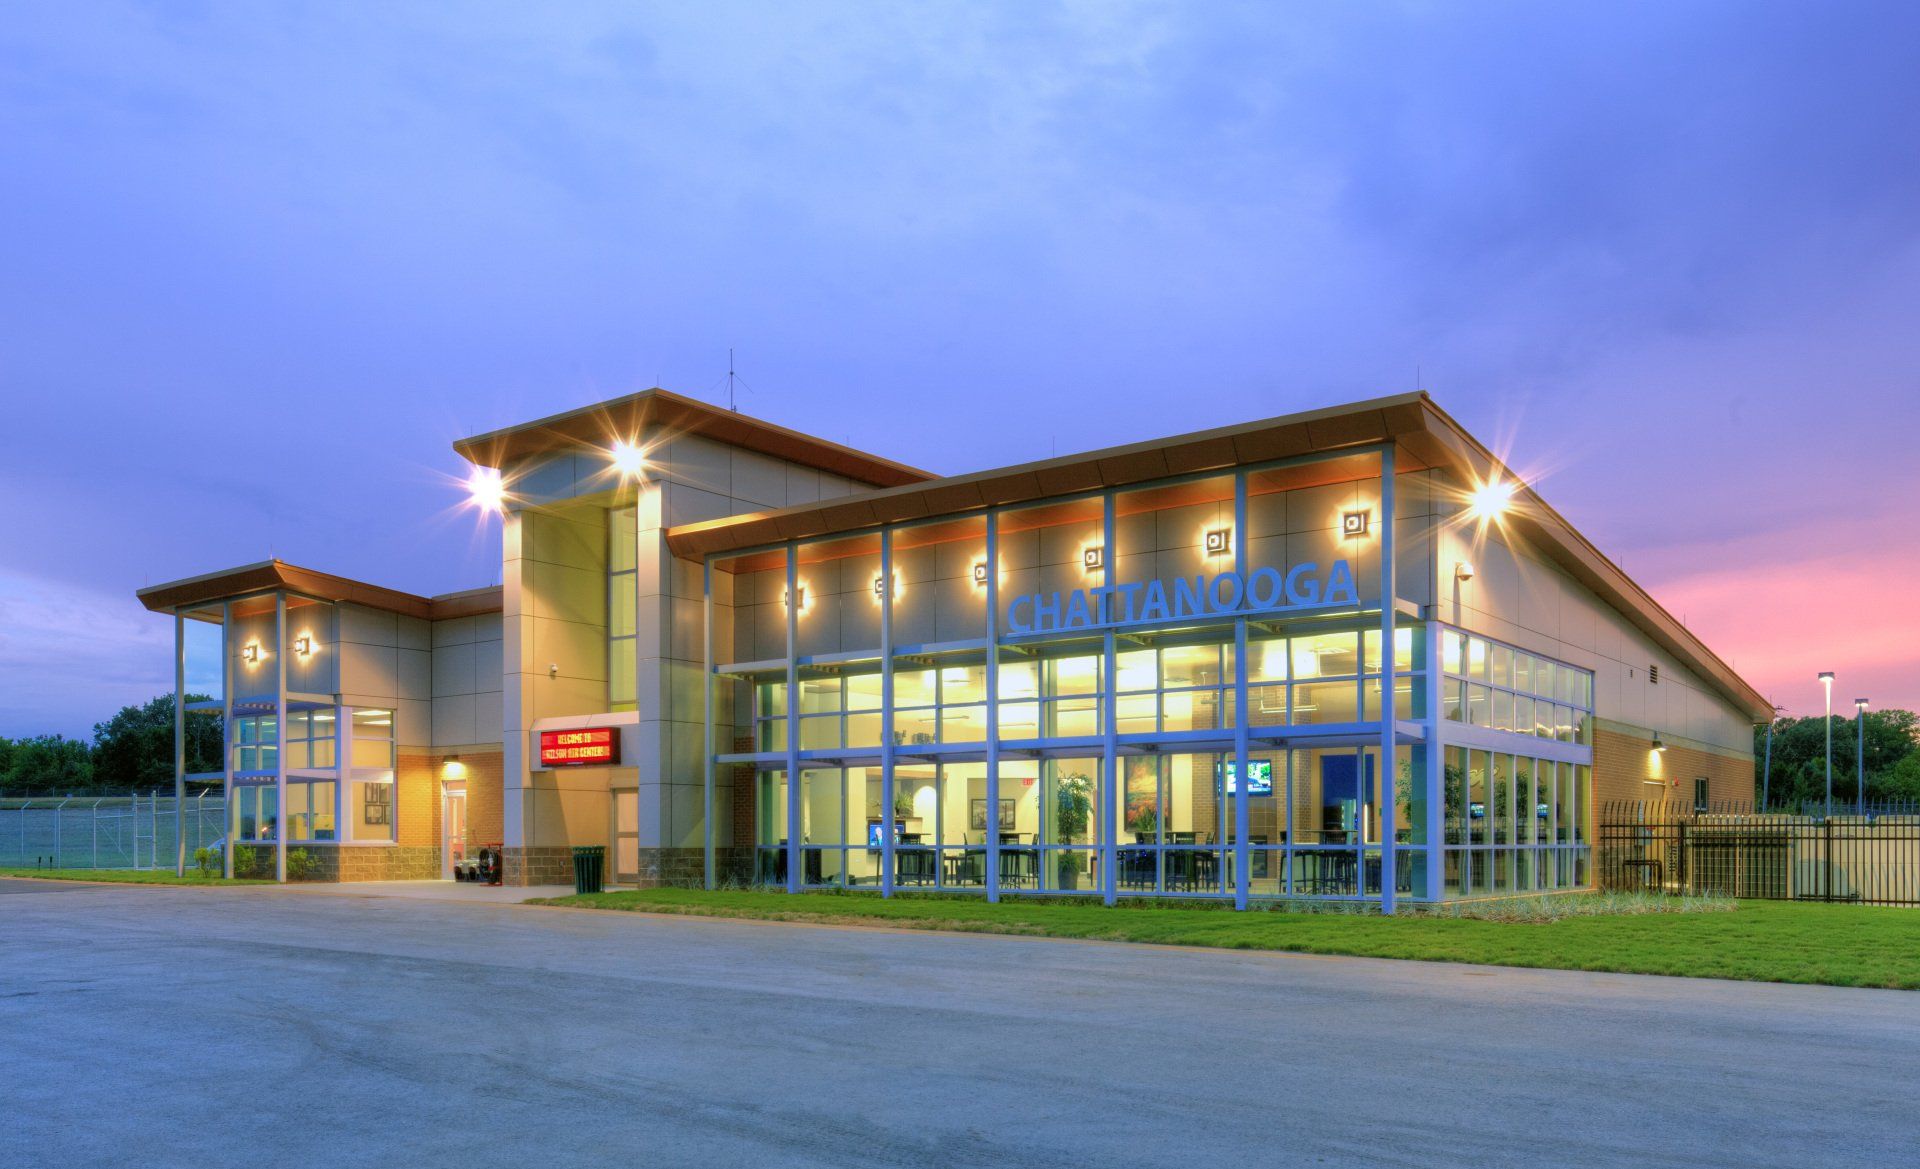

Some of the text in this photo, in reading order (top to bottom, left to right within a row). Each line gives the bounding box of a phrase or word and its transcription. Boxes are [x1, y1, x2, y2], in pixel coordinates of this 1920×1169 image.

[1007, 559, 1358, 633] CHATTANOOGA
[558, 733, 591, 744] WELCOME TO
